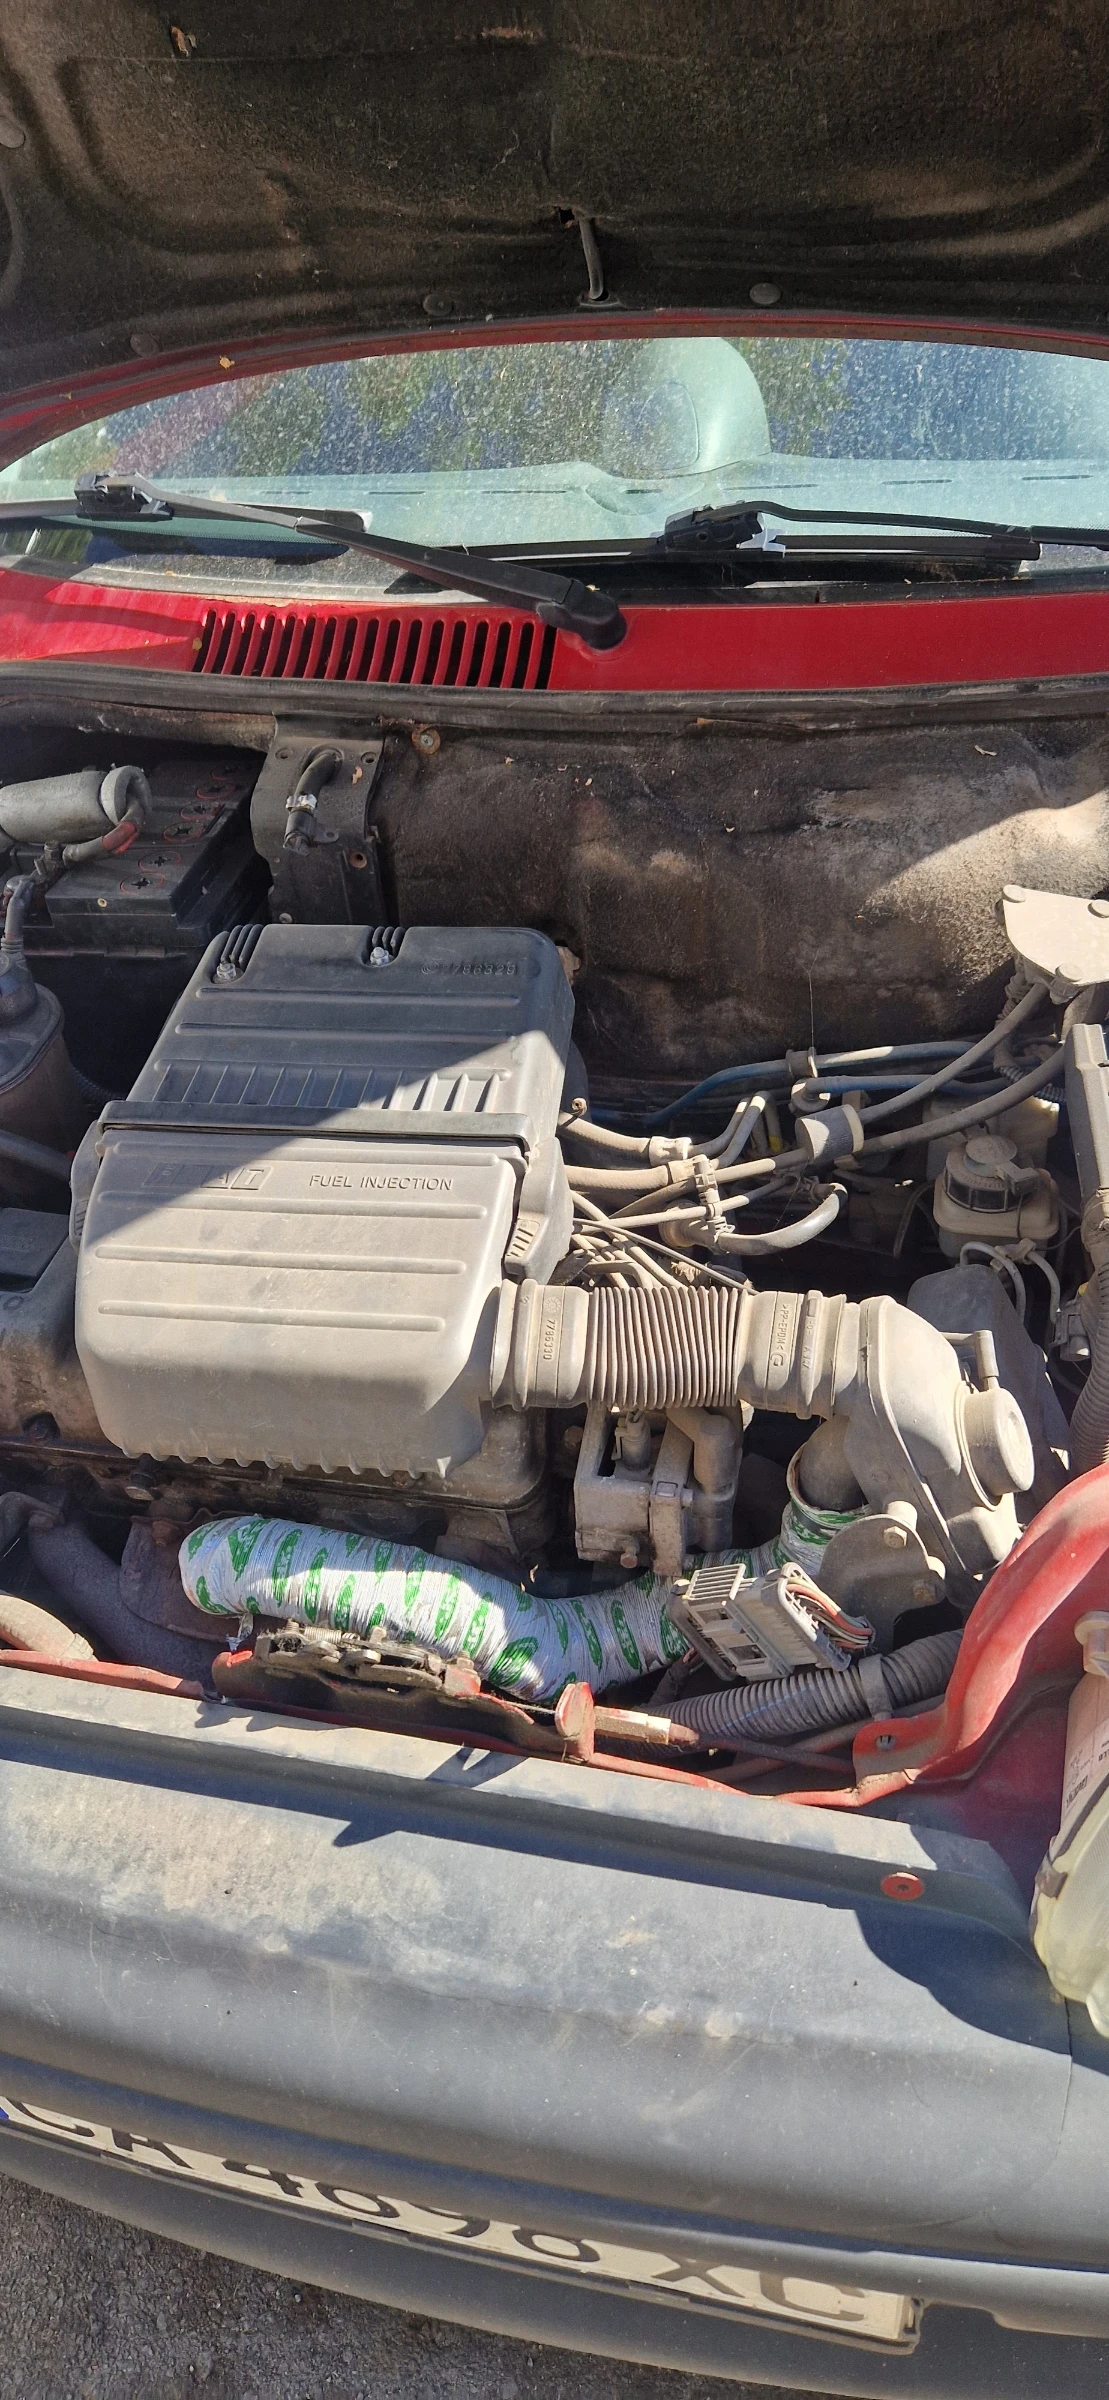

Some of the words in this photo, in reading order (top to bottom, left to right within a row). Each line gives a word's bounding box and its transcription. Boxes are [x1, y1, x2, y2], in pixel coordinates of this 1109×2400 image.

[309, 1174, 353, 1189] FUEL
[360, 1176, 454, 1192] INJECTION
[543, 1319, 556, 1360] 7786330
